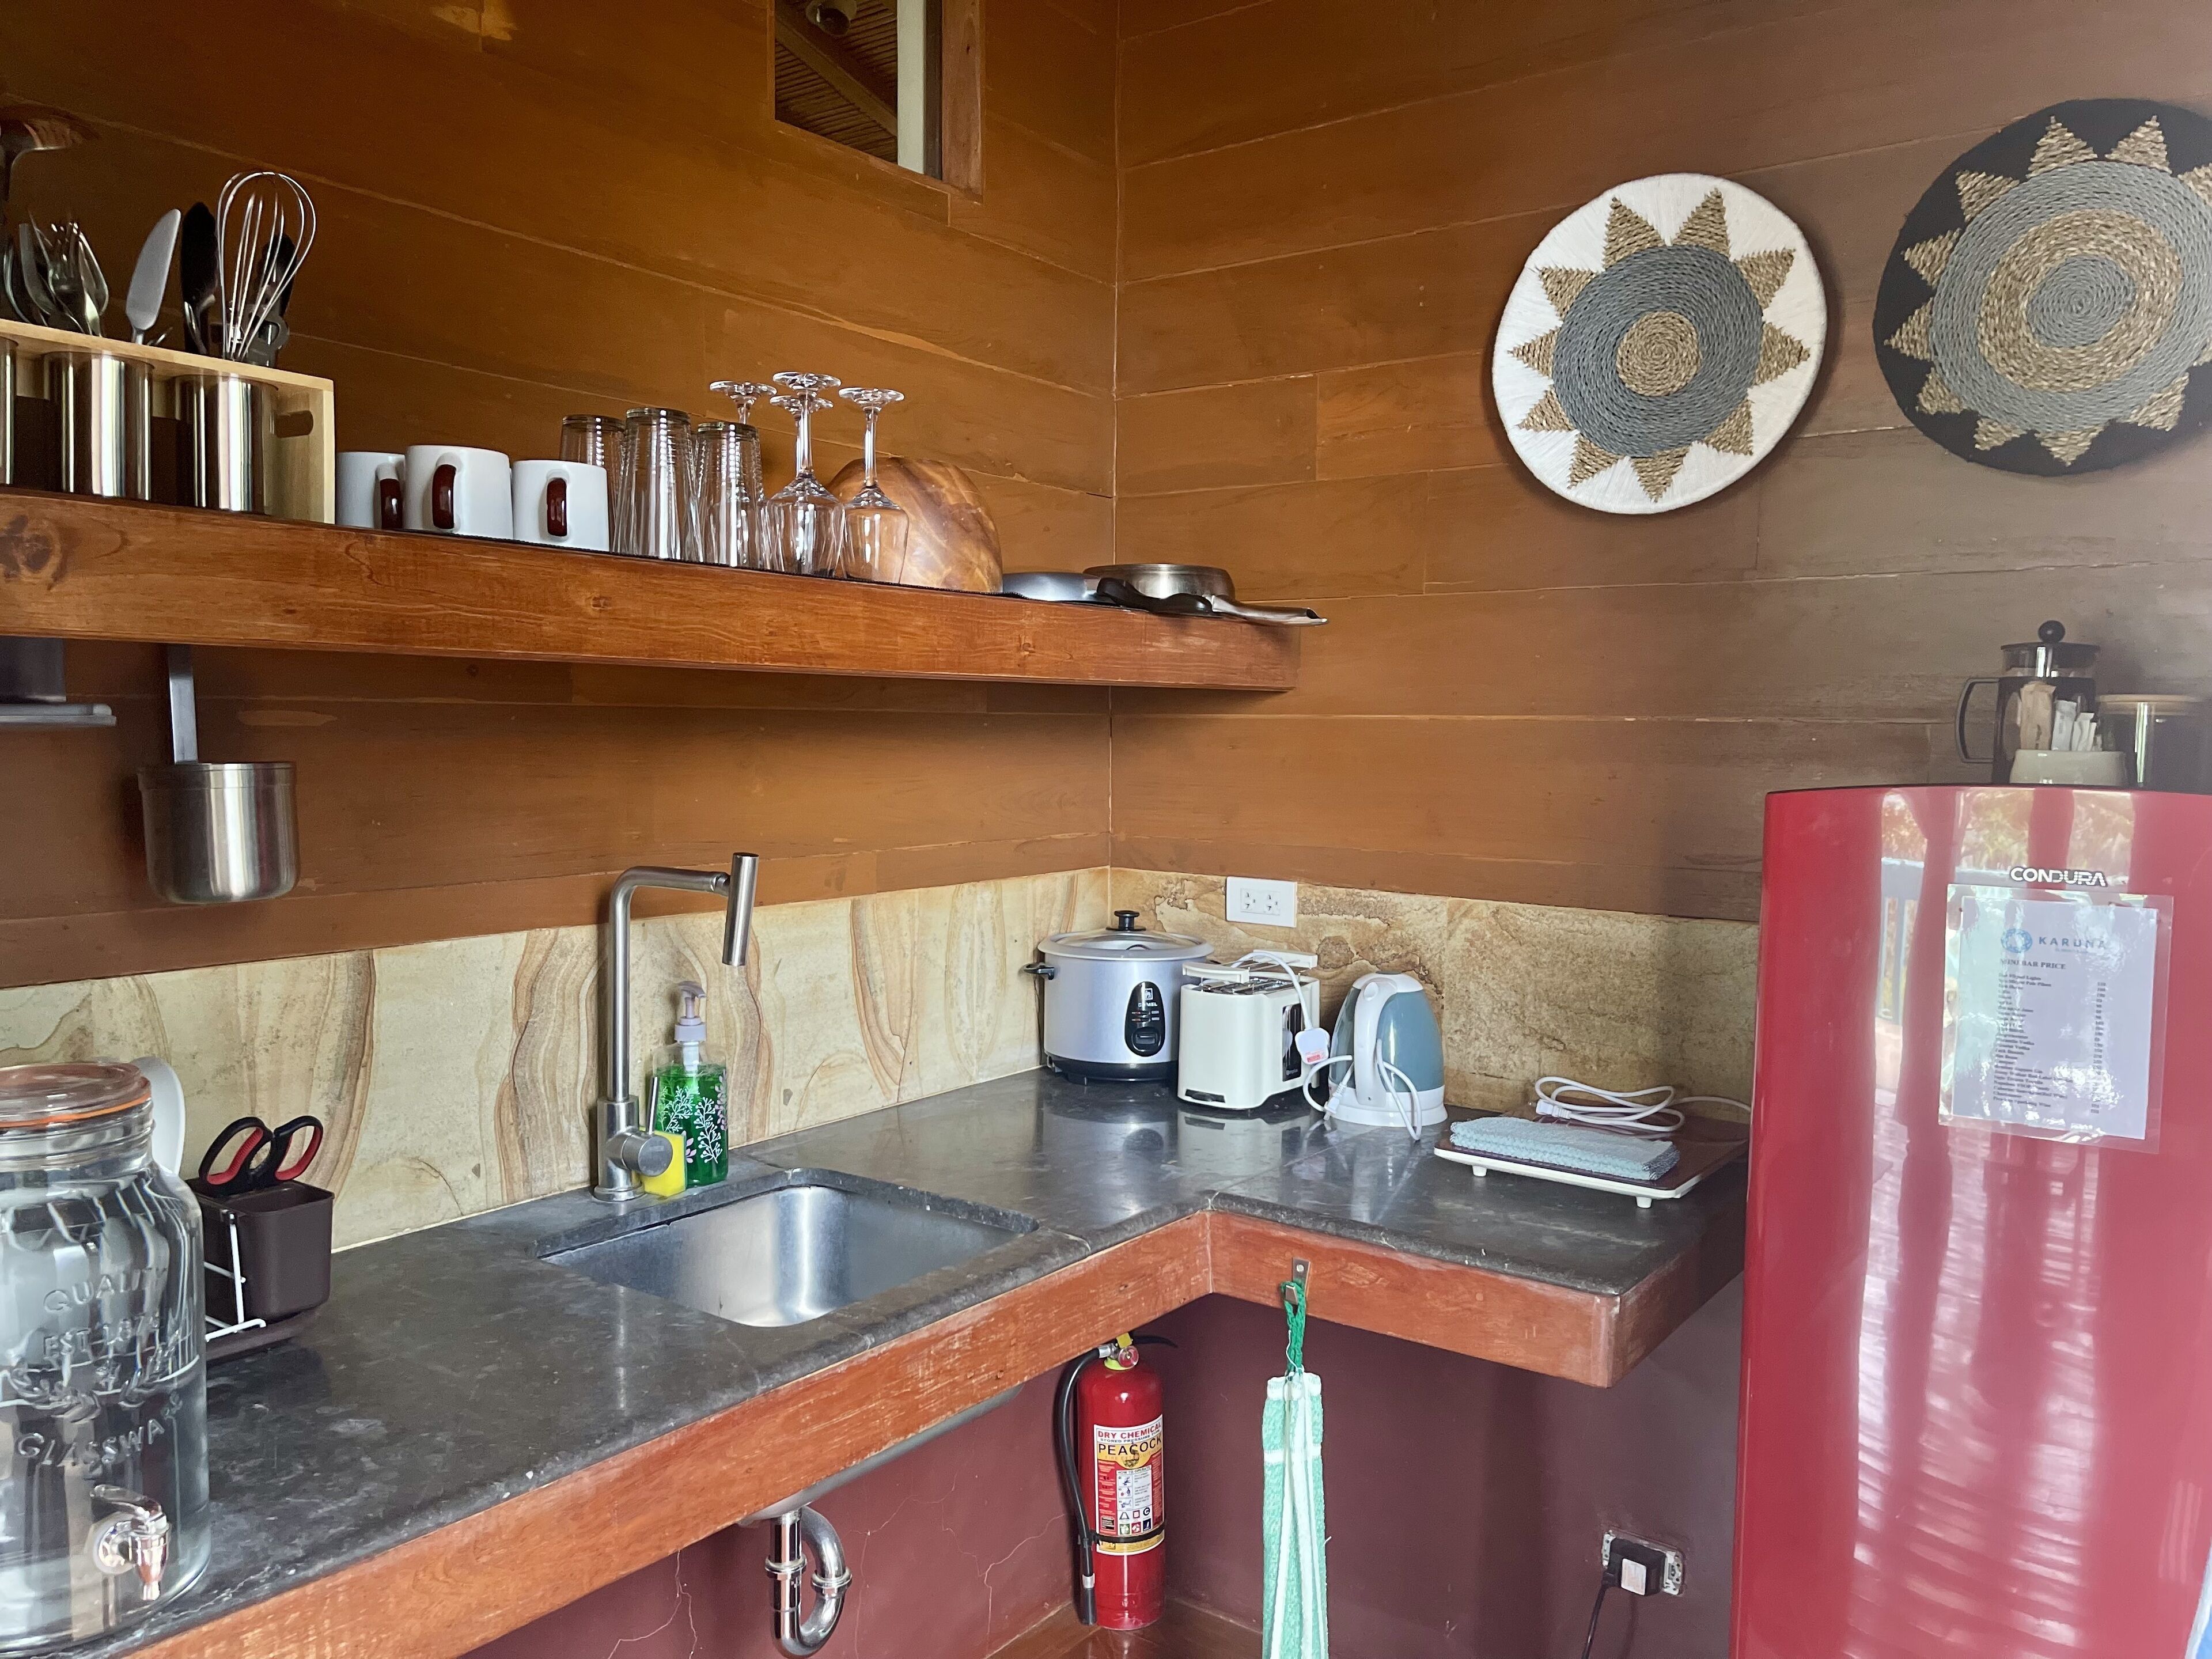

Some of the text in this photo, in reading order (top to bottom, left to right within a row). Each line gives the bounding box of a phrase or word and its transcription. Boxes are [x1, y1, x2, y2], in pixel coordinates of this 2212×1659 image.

[2009, 866, 2107, 887] CONDURA
[2039, 936, 2107, 949] KARUNA
[2040, 961, 2067, 969] PRICE
[1098, 1422, 1161, 1439] DRY CHEMICAL
[1098, 1434, 1162, 1456] PEACOCK
[1123, 1434, 1150, 1443] PRESSURE
